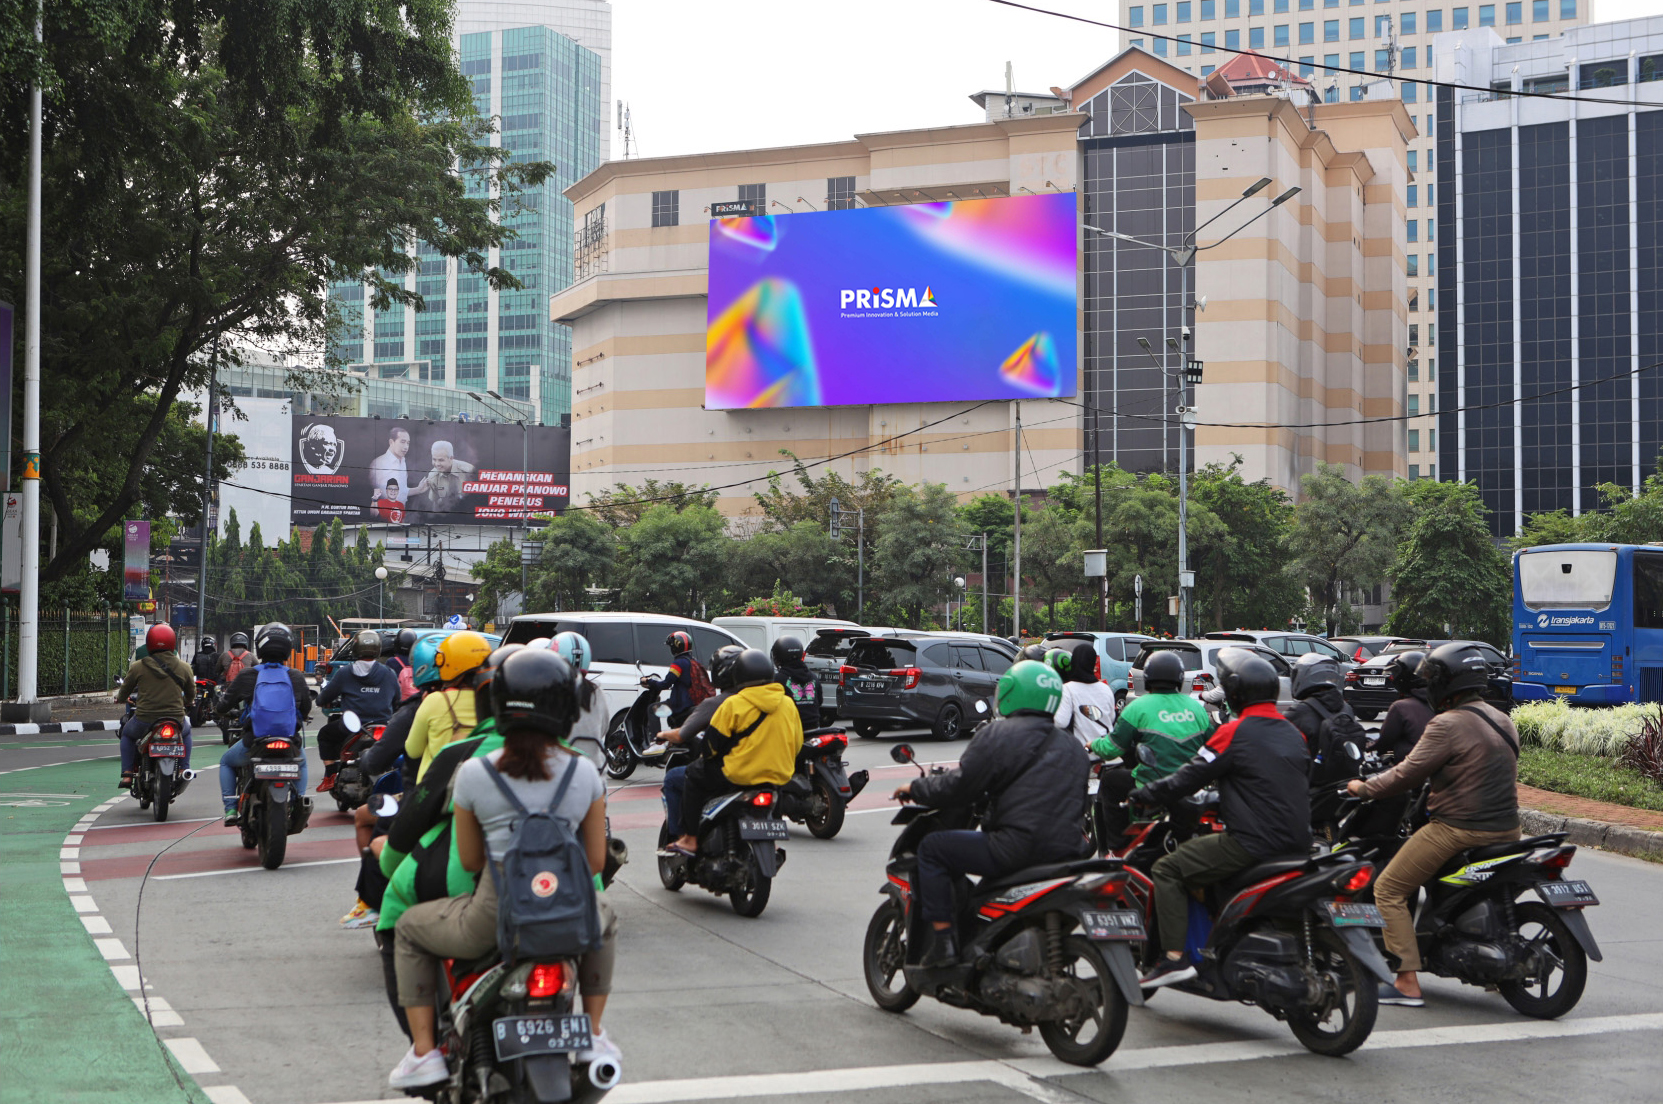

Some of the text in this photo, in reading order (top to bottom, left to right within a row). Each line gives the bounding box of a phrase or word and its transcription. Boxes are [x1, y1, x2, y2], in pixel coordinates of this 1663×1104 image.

[251, 461, 267, 469] 535
[269, 462, 290, 471] 8888
[293, 474, 349, 484] GANJARIAN
[479, 471, 553, 483] MENANGKAN
[463, 483, 567, 496] GANJAR PRANOWO
[489, 496, 543, 506] PENERUS
[475, 507, 505, 518] JOKO
[1550, 615, 1595, 627] transjakarta
[1158, 709, 1195, 723] Grab
[1551, 885, 1570, 894] 3912
[496, 1022, 506, 1041] B
[516, 1019, 555, 1036] 6926
